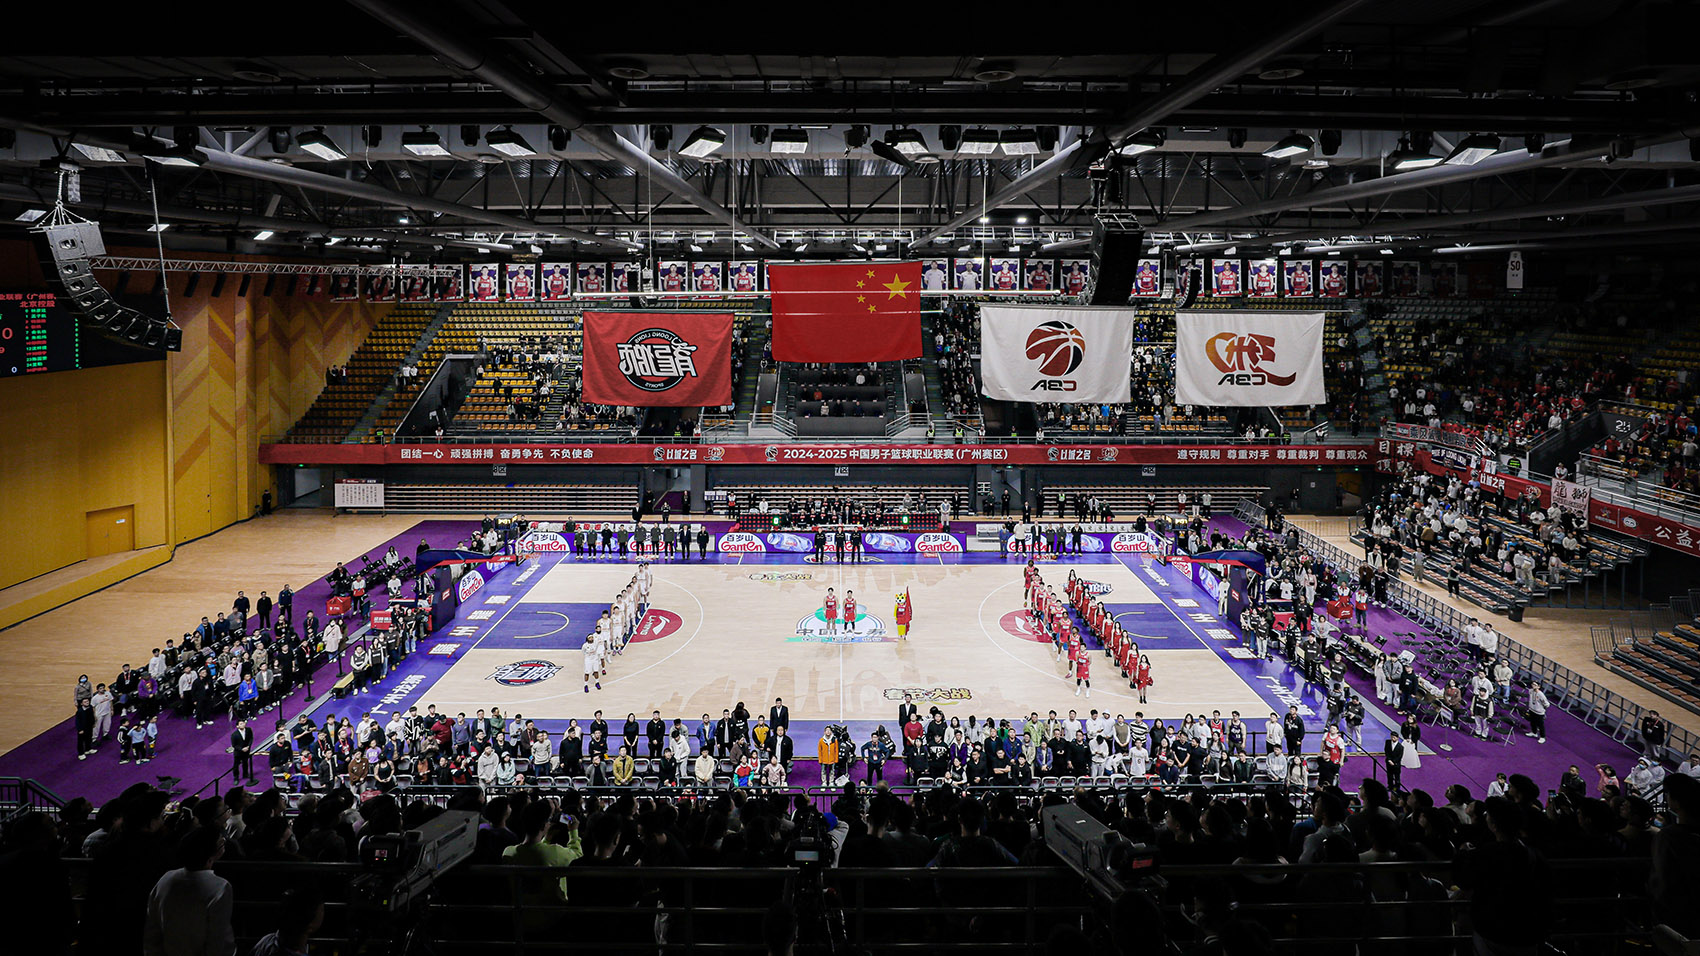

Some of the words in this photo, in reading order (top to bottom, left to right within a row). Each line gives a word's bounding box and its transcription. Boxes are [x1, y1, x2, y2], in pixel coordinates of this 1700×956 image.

[1510, 260, 1521, 271] 50
[20, 300, 56, 308] 北京控股
[2, 327, 13, 340] 0
[401, 449, 444, 459] 团结一心
[450, 449, 494, 459] 顽强拼搏
[500, 449, 544, 459] 奋勇争先
[550, 449, 594, 459] 不负使命
[784, 449, 847, 459] 2024-2025
[1177, 449, 1220, 460] 遵守规则
[1227, 449, 1270, 460] 尊重对手
[1276, 449, 1319, 460] 尊重裁判
[1325, 449, 1368, 460] 尊重观众
[727, 534, 753, 542] 百岁山
[923, 534, 949, 542] 百岁山
[1655, 526, 1700, 552] 公益
